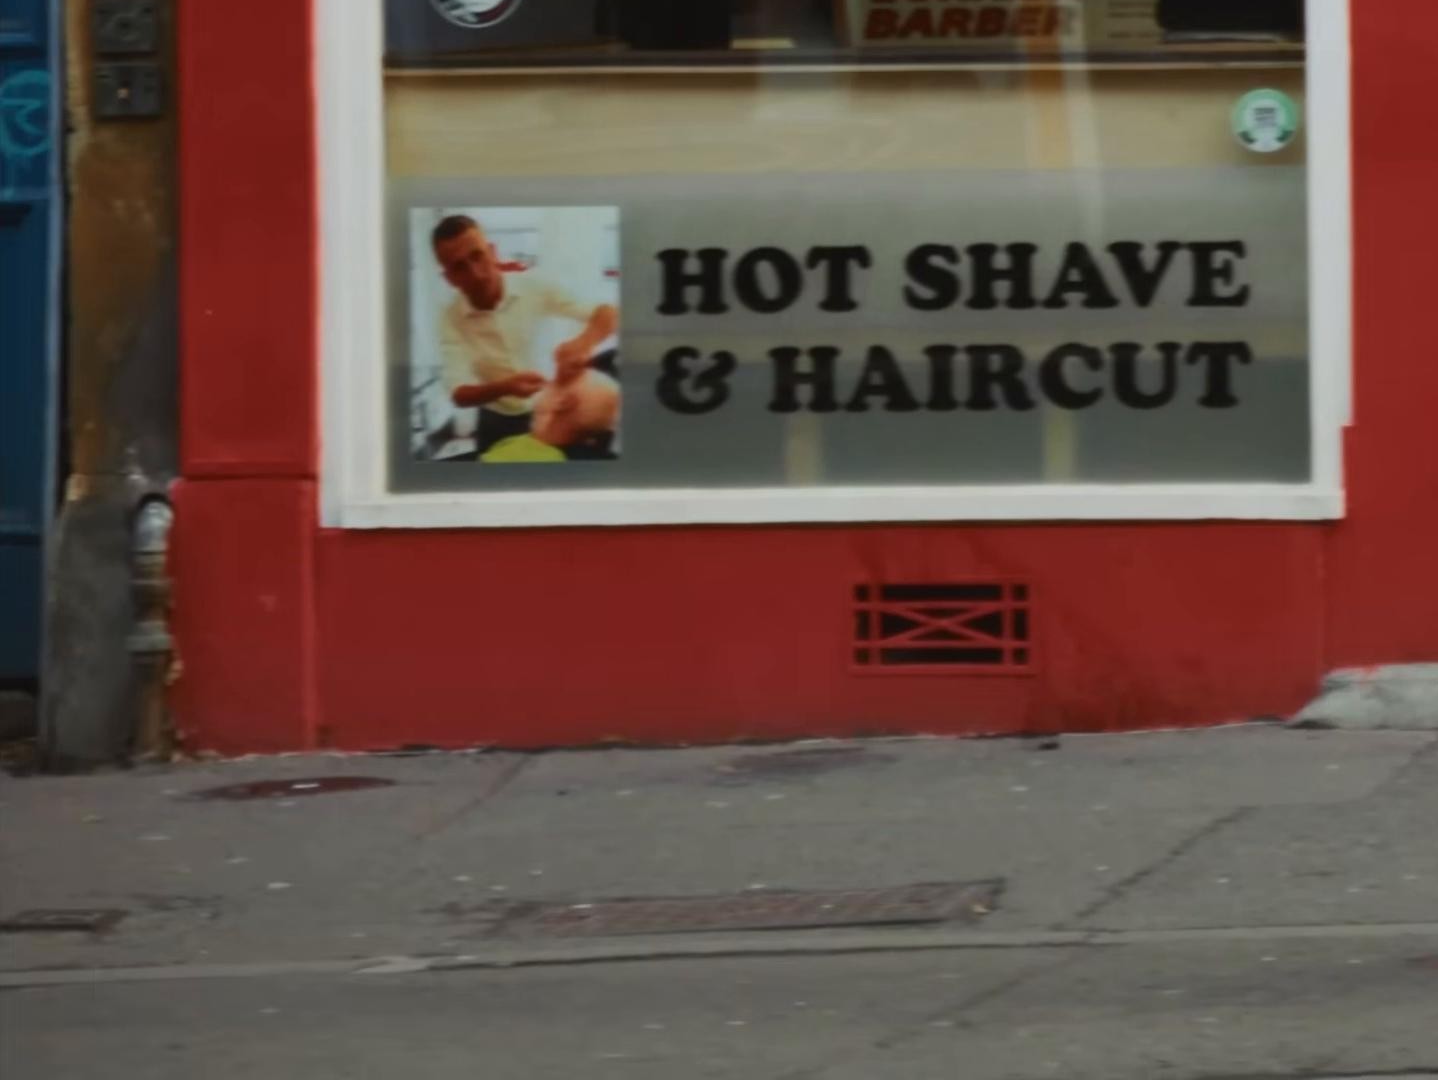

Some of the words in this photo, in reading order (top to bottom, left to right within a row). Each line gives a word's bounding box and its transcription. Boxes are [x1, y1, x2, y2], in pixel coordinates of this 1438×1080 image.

[865, 4, 1083, 40] BARBER
[655, 244, 872, 316] HOT
[901, 239, 1252, 311] SHAVE
[655, 345, 737, 415] &
[766, 339, 1253, 414] HAIRCUT
